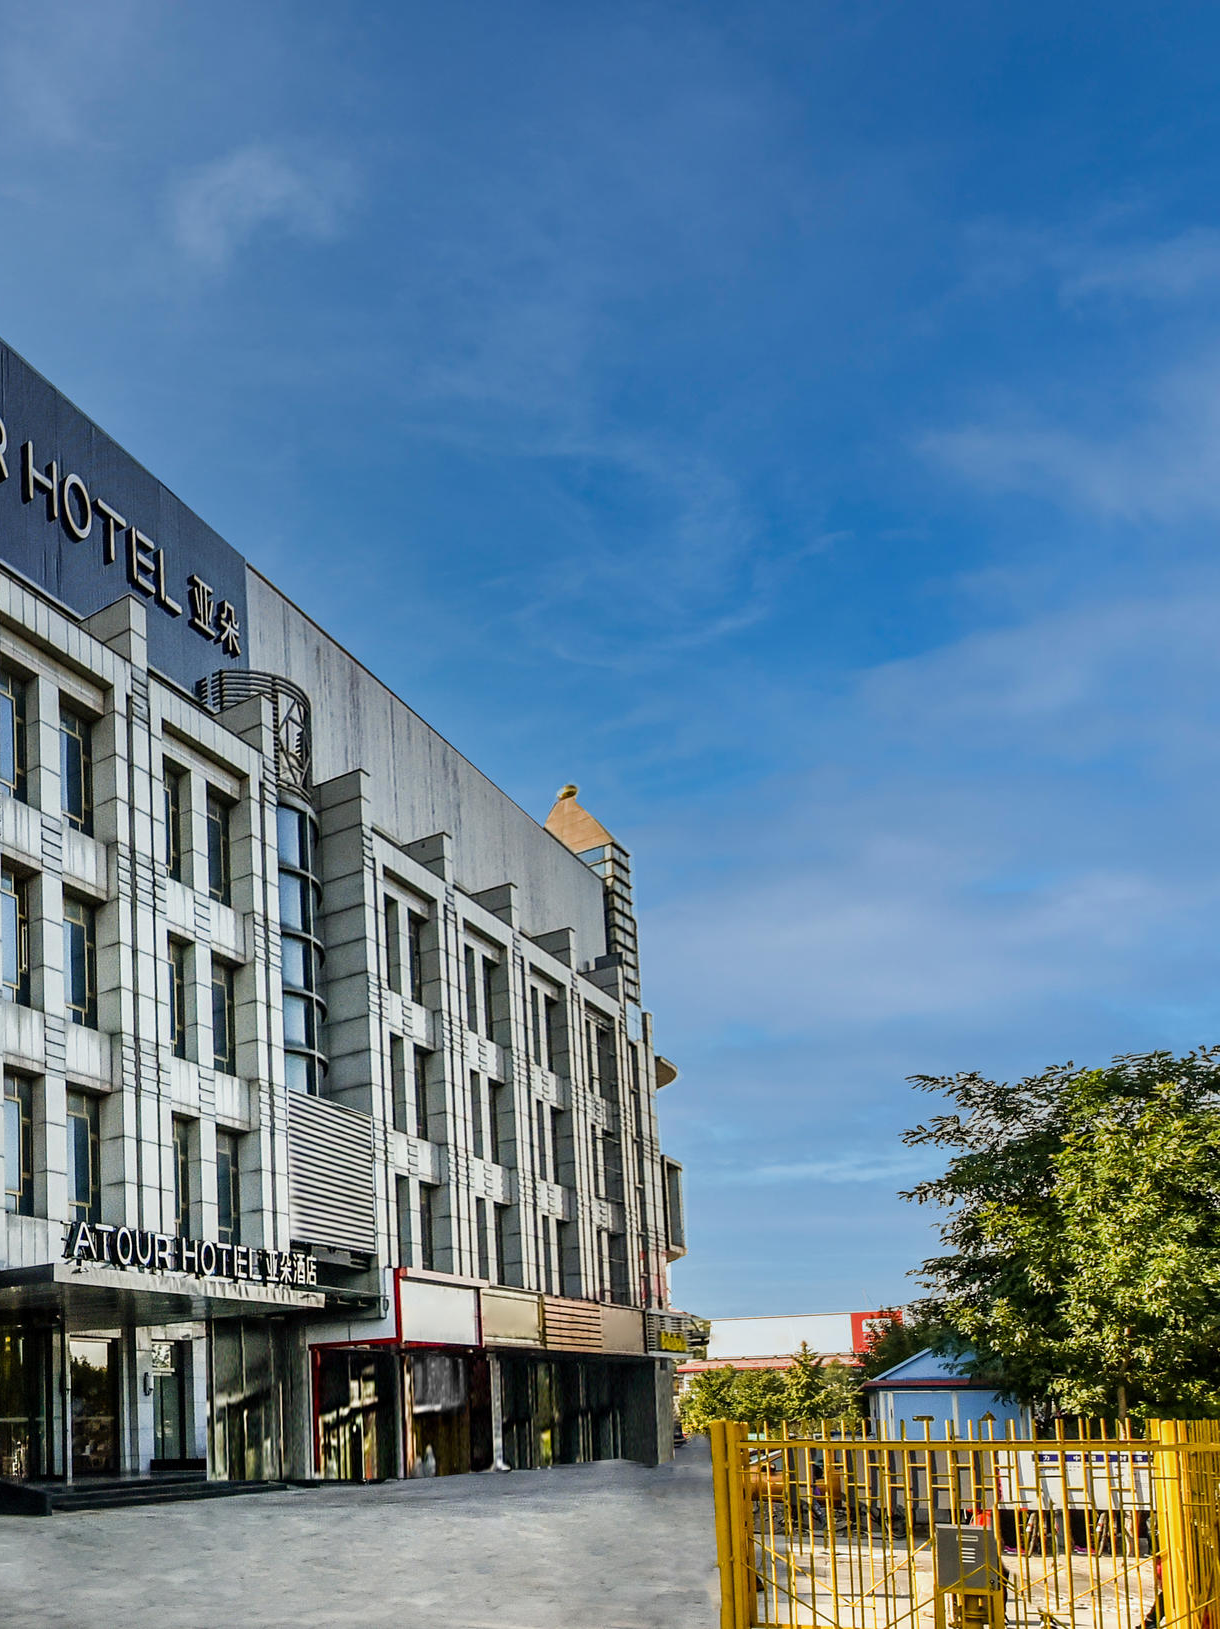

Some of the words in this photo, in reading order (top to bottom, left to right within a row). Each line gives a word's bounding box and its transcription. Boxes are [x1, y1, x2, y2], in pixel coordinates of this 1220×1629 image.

[26, 439, 183, 616] HOTEL
[191, 573, 242, 655] 亚朵
[72, 1220, 171, 1270] ATOUR
[181, 1236, 263, 1281] HOTEL
[265, 1249, 318, 1287] 亚朵酒店
